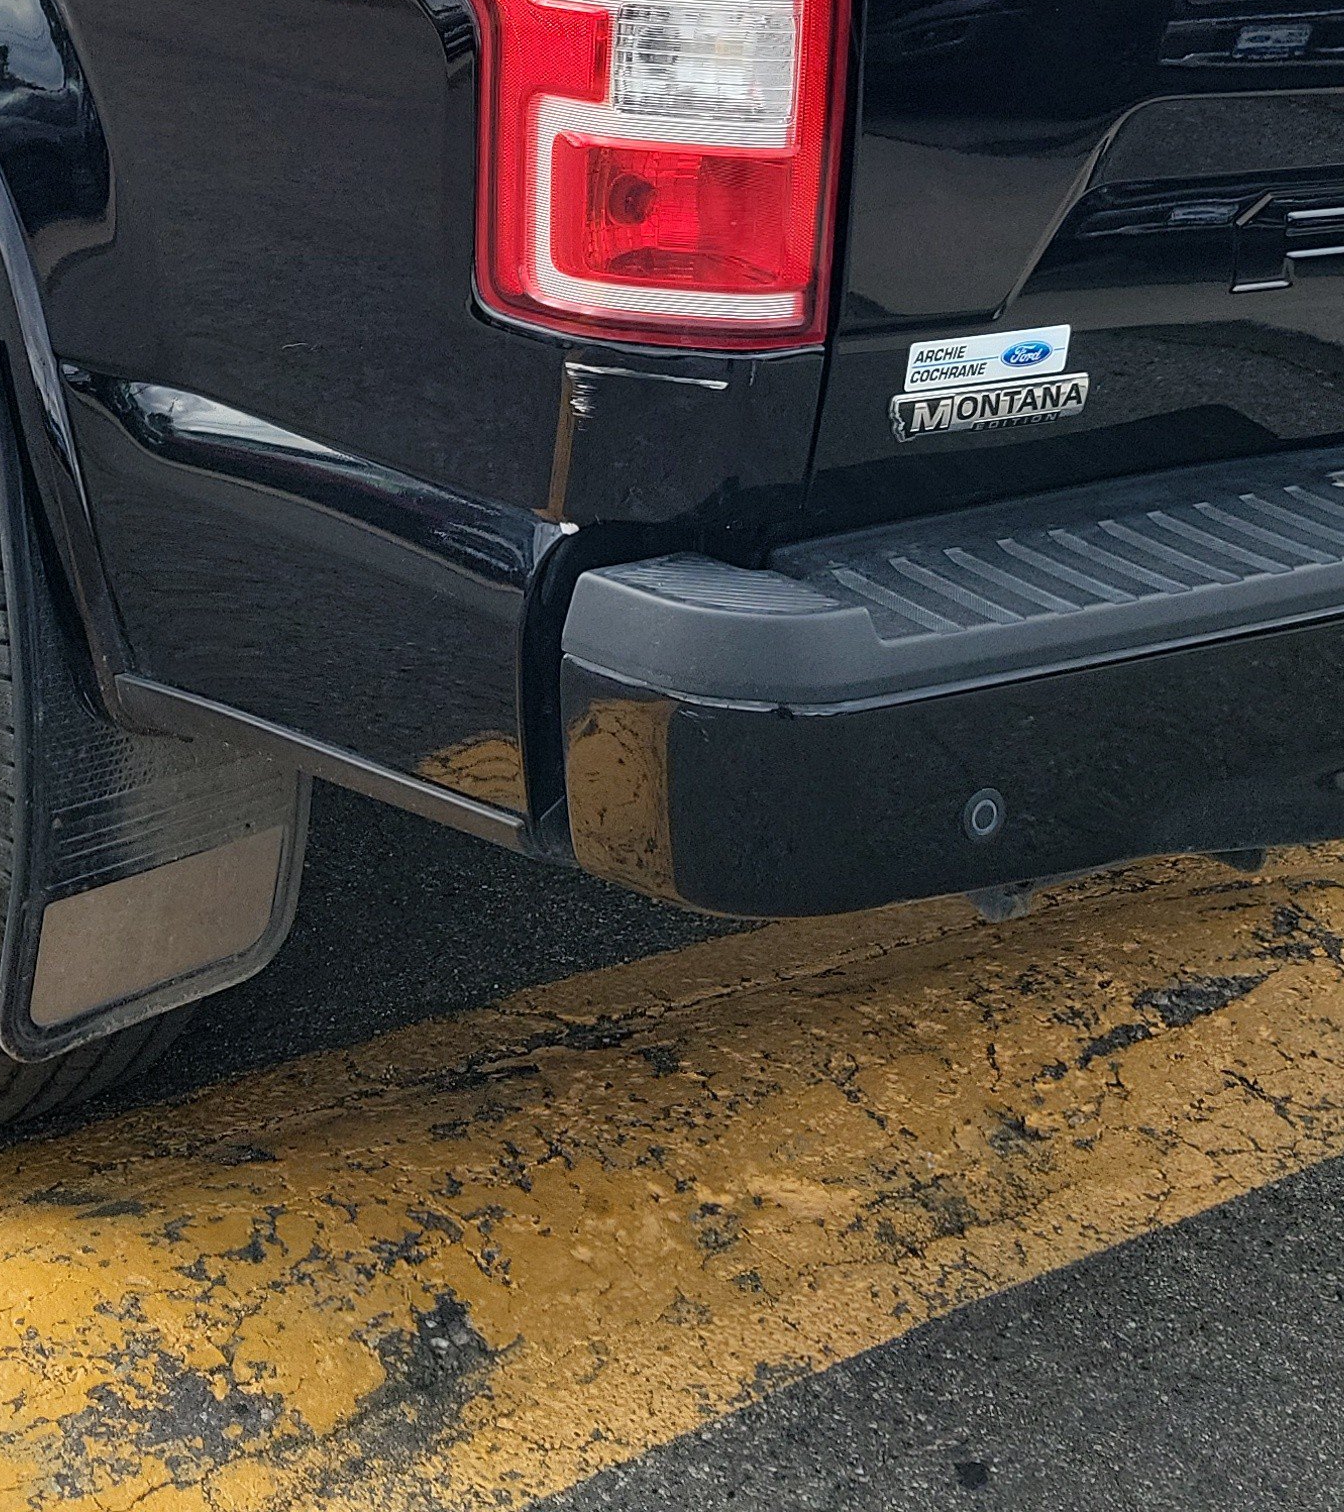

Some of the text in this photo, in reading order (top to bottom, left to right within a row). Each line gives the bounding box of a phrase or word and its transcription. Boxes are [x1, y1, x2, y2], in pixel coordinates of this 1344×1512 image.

[913, 345, 967, 365] ARCHIE
[1011, 344, 1044, 364] Ford
[909, 362, 988, 384] COCHRANE
[910, 383, 1083, 433] MONTANA
[975, 412, 1057, 431] EDITION
